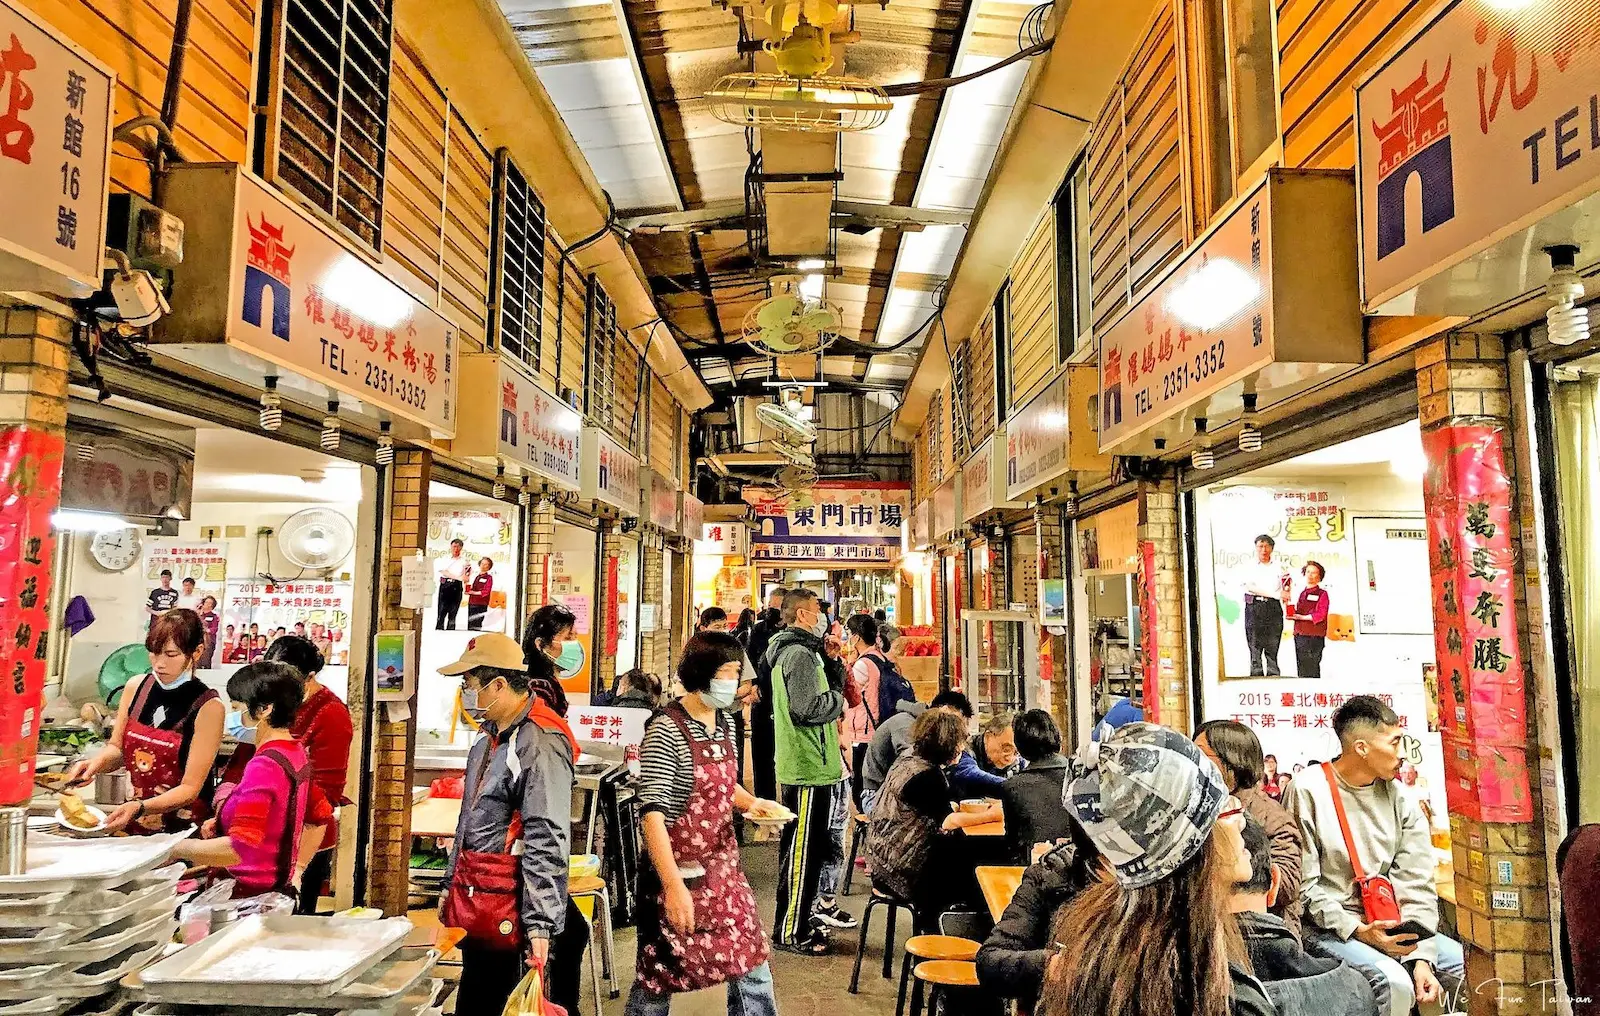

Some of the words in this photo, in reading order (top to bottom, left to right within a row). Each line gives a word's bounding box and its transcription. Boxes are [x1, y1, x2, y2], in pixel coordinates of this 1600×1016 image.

[55, 69, 87, 250] 新館16號
[1250, 201, 1263, 348] 新館號
[364, 361, 427, 411] 2351-3352
[1163, 339, 1226, 401] 2351-3352
[793, 503, 902, 529] 東門市場
[773, 545, 826, 557] 歡迎光臨
[833, 546, 886, 558] 東門市場
[240, 584, 260, 593] 2015
[1465, 502, 1512, 674] 萬馬奔騰
[1239, 693, 1272, 706] 2015
